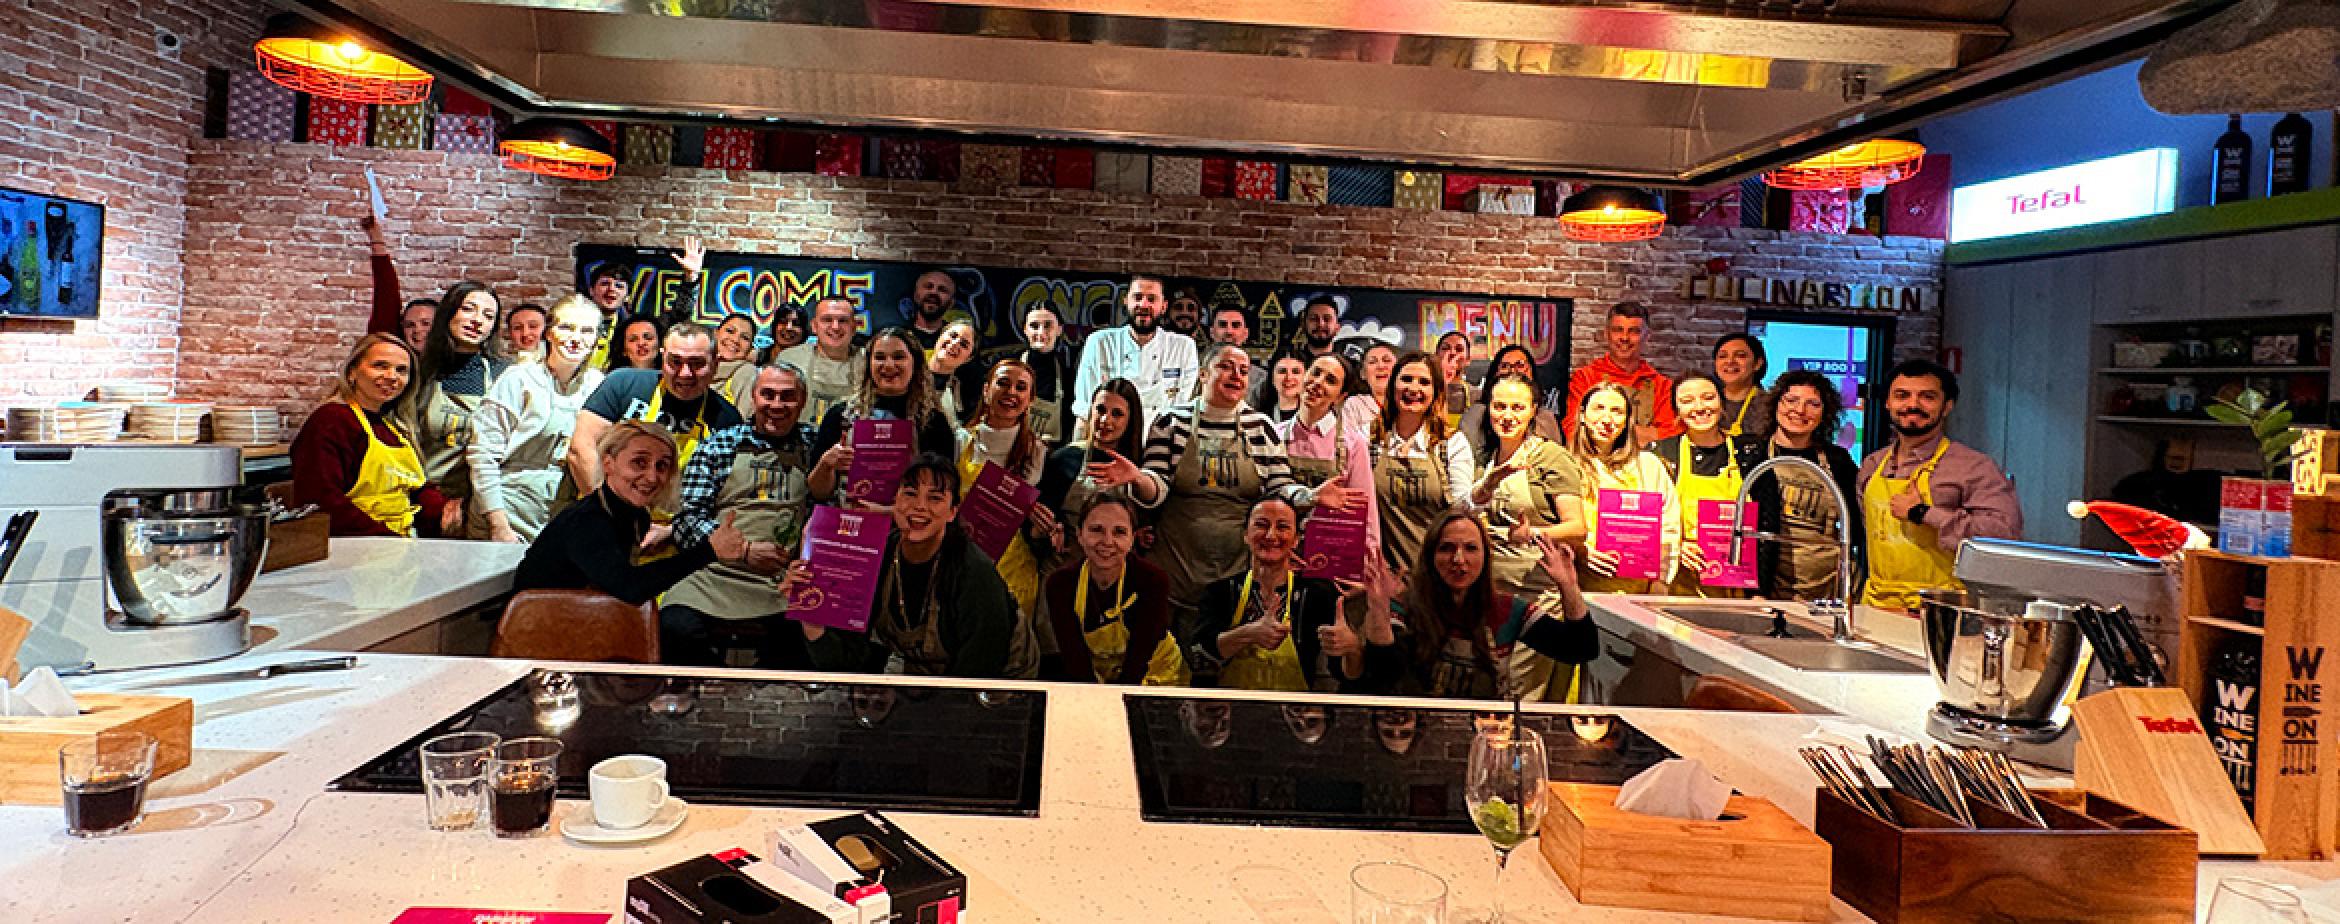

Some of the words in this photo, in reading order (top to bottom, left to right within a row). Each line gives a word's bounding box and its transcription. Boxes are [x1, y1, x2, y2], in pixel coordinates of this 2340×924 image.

[2006, 184, 2087, 214] Tefal
[1418, 299, 1557, 365] MENU
[2136, 715, 2203, 735] Tefal
[2283, 719, 2318, 738] ON
